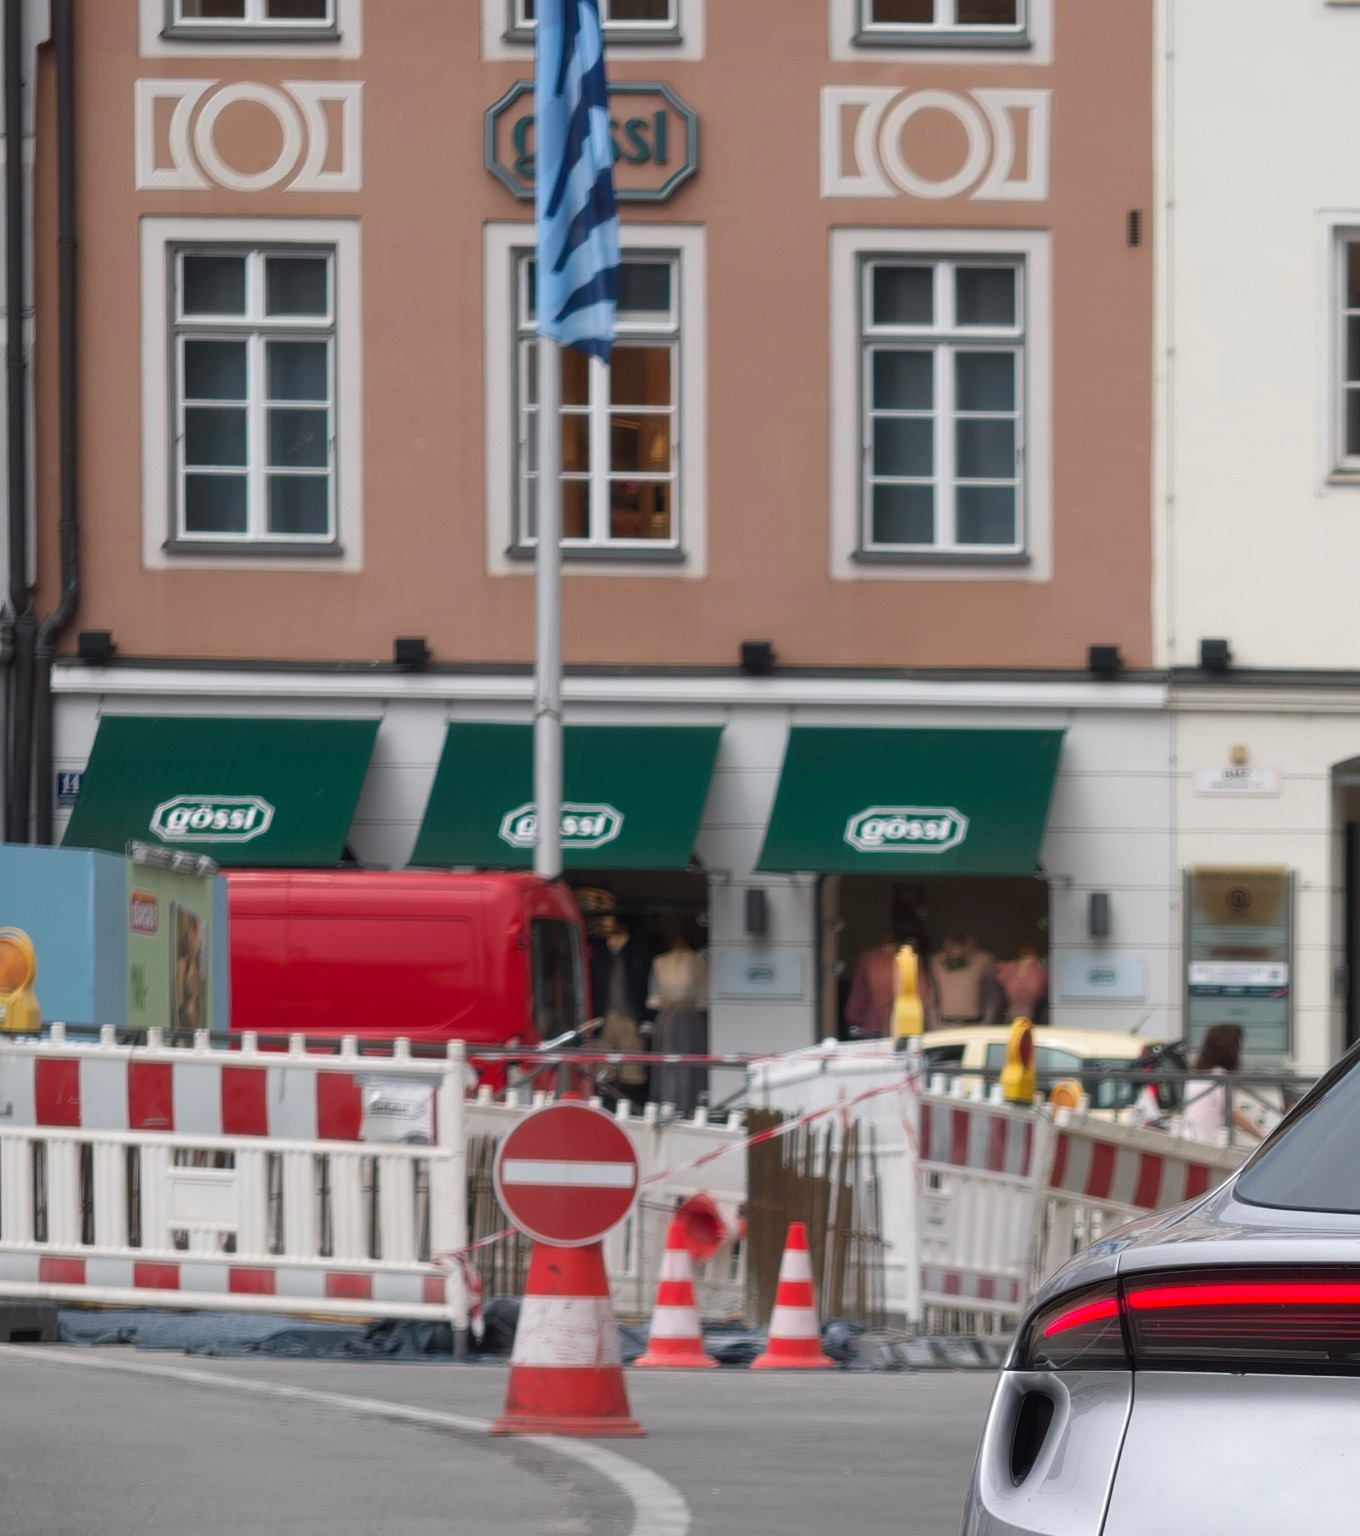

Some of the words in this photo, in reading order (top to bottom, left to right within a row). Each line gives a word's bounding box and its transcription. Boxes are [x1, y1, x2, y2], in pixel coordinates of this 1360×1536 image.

[165, 805, 258, 833] gössl
[515, 813, 606, 840] gssl
[860, 815, 953, 844] gössl
